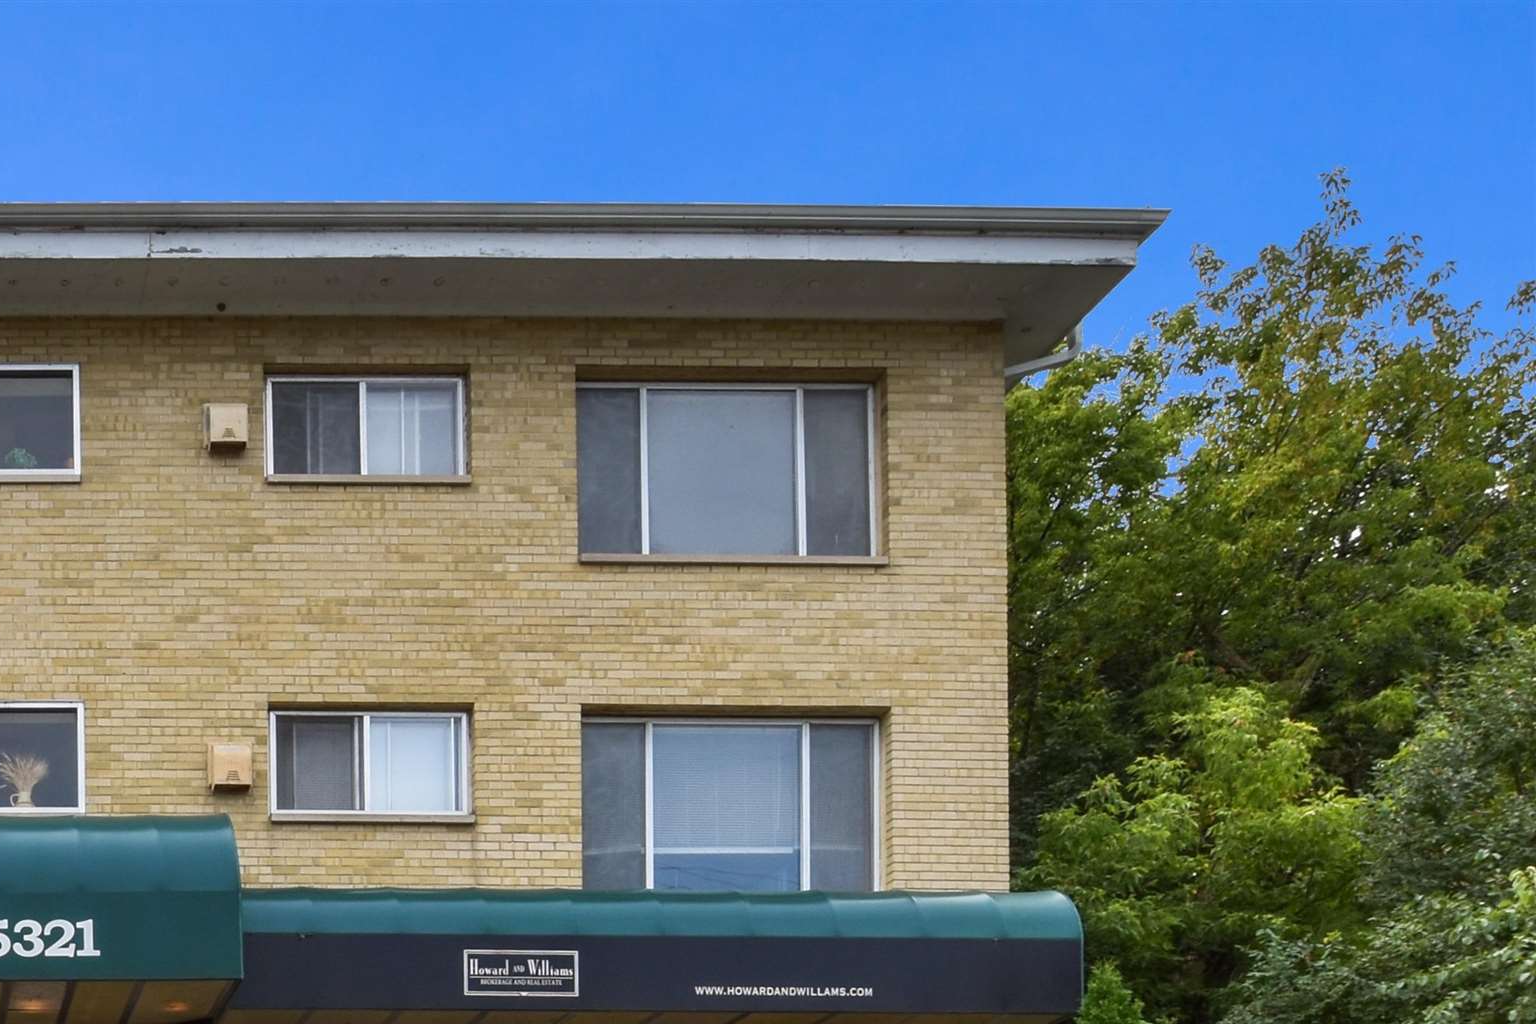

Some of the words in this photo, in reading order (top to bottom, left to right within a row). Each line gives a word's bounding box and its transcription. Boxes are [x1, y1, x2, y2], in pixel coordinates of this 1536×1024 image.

[469, 958, 509, 976] Howard
[513, 964, 525, 973] AND
[527, 959, 574, 976] Williams
[694, 986, 874, 997] WWW.HOWARDANDWILLAMS.COM
